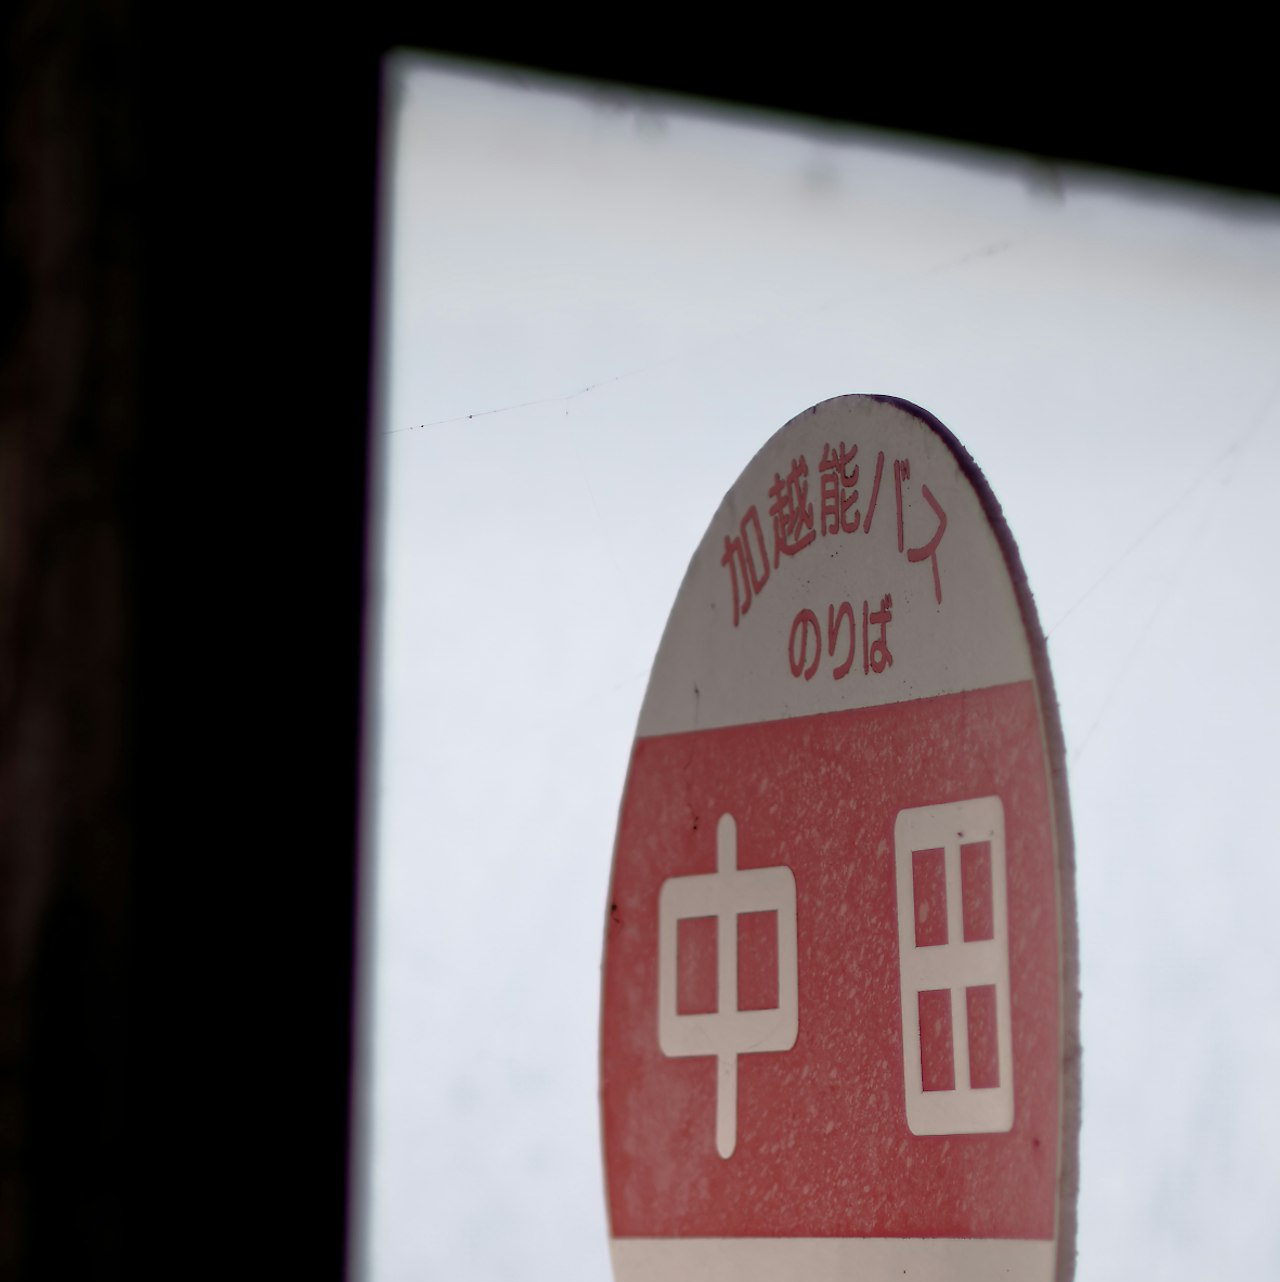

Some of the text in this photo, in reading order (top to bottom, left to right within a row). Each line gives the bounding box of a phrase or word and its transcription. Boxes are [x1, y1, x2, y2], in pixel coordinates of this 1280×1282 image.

[721, 441, 948, 627] 加越能バス
[787, 594, 893, 681] のりば
[658, 795, 1014, 1160] 中田
